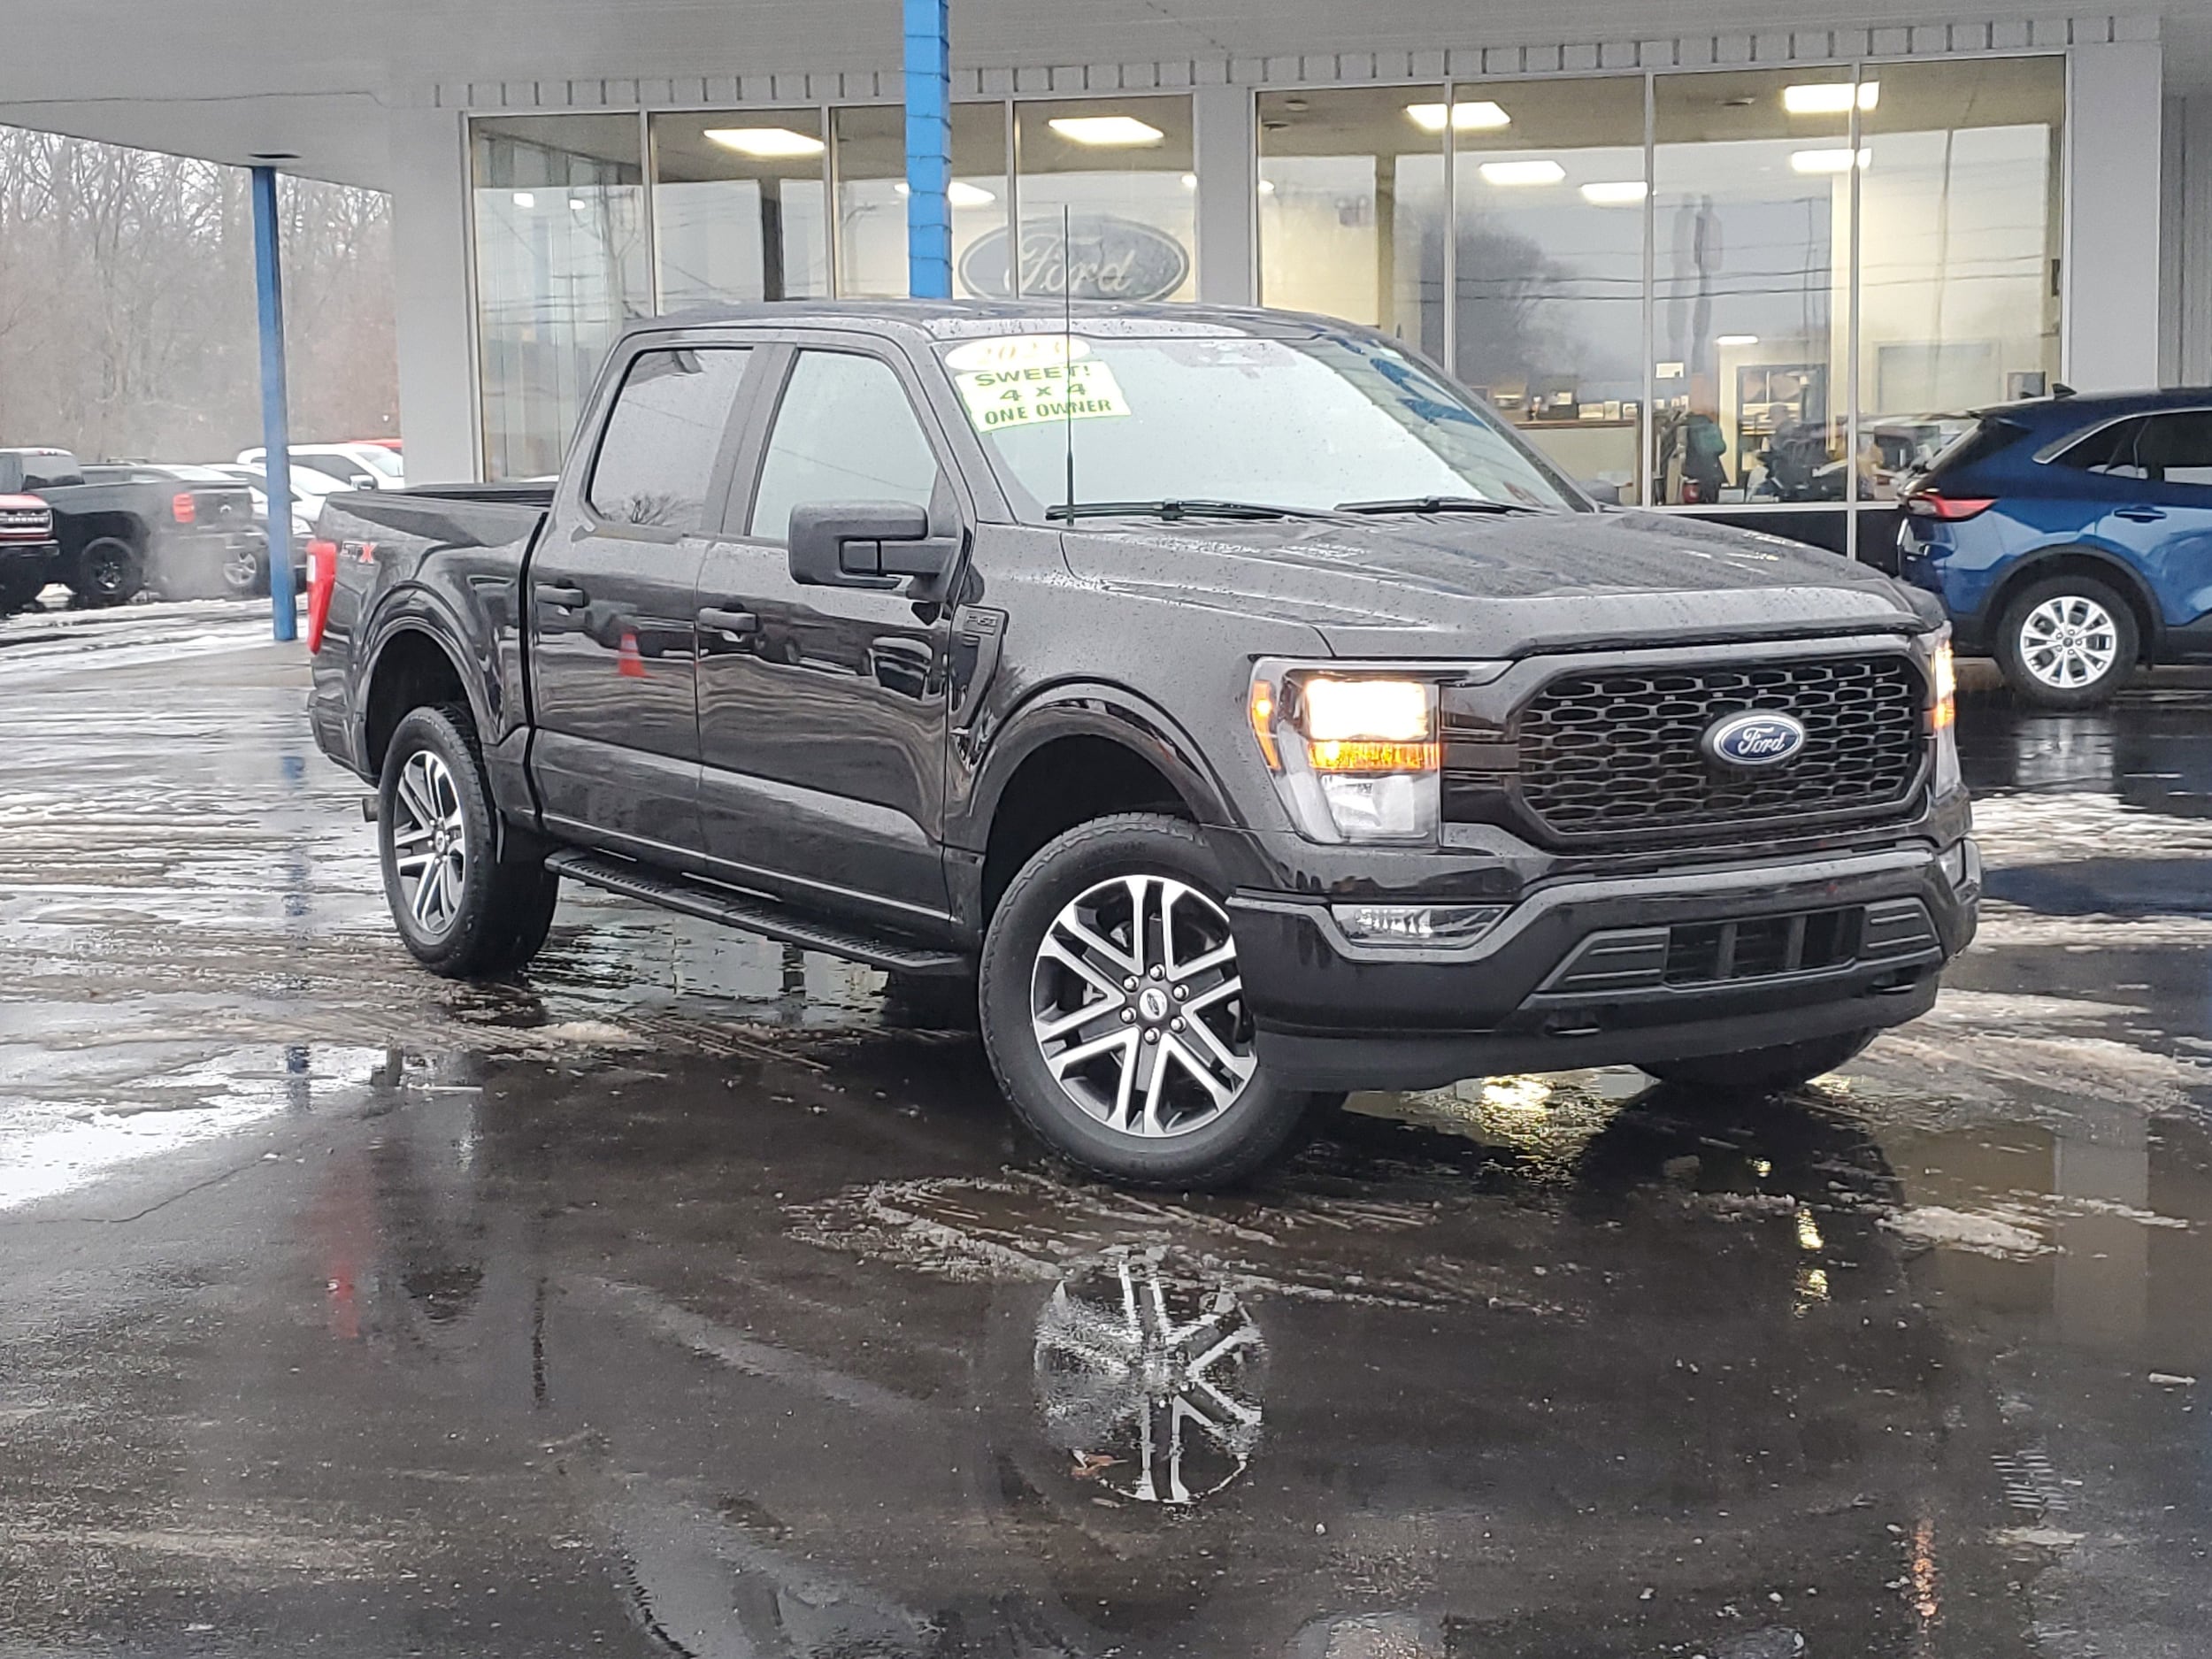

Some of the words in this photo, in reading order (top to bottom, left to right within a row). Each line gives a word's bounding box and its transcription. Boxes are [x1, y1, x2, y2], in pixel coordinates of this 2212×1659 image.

[1002, 234, 1136, 292] Ford
[974, 365, 1091, 387] SWEET!
[985, 406, 1028, 425] ONE
[1036, 399, 1112, 417] OWNER
[1737, 726, 1786, 755] Ford
